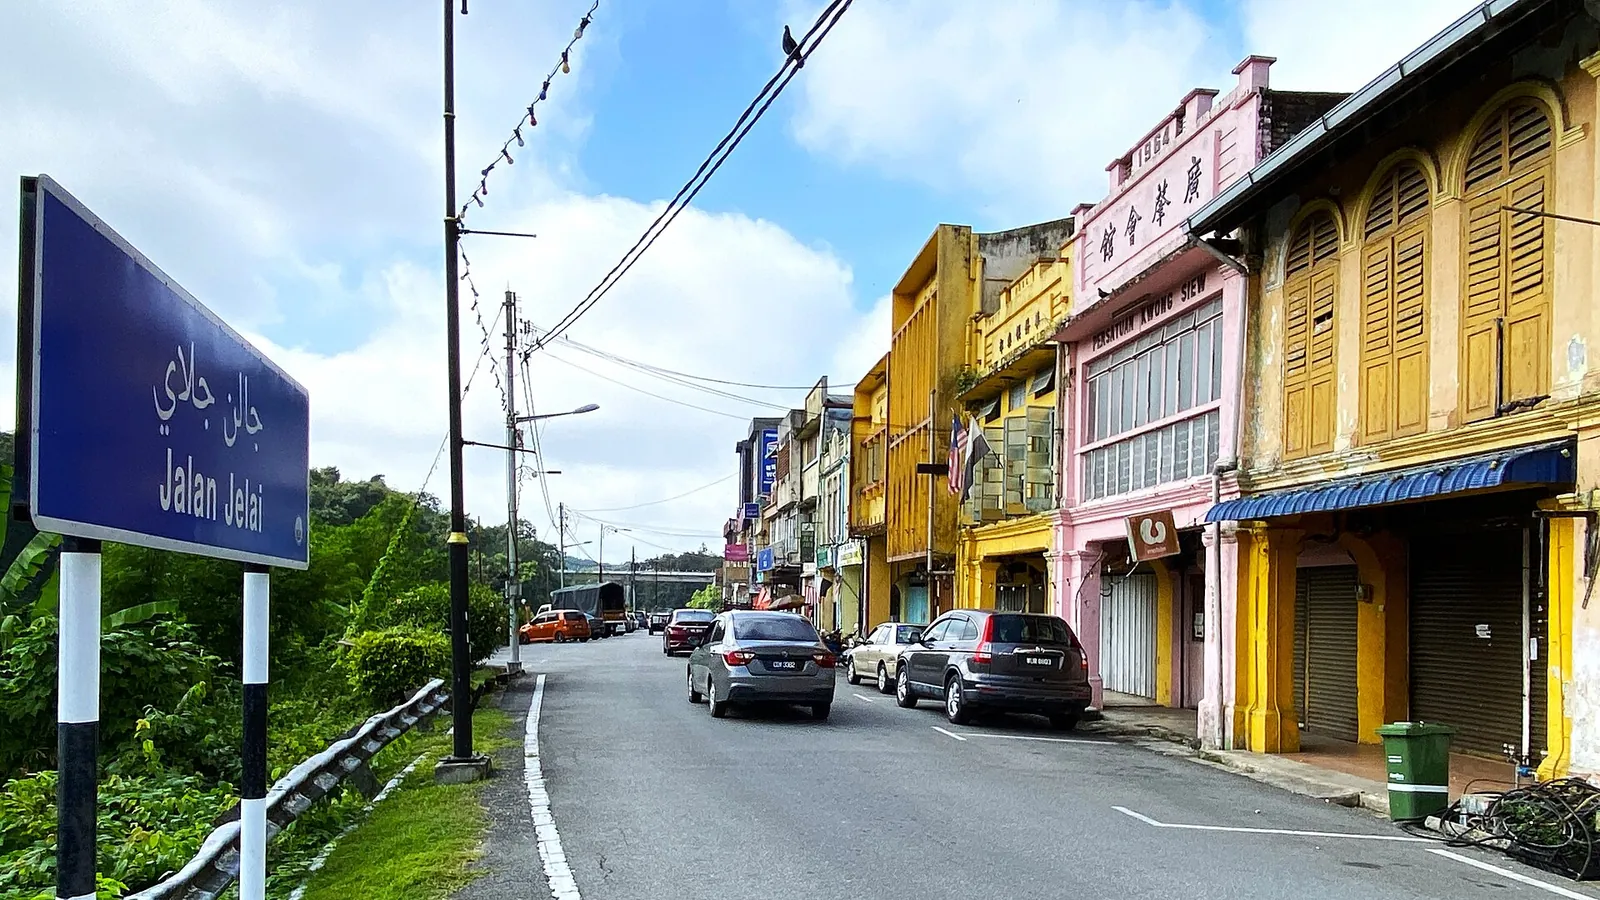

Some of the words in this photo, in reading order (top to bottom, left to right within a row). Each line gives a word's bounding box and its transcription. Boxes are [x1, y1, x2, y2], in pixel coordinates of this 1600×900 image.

[1139, 125, 1170, 167] 1964
[1092, 316, 1134, 352] PERSATUAN
[1141, 292, 1173, 326] KWONG
[1181, 271, 1207, 302] SIEW
[153, 341, 215, 437] جلاي
[223, 372, 263, 453] جالن
[159, 447, 217, 521] Jalan
[224, 472, 264, 533] Jelai
